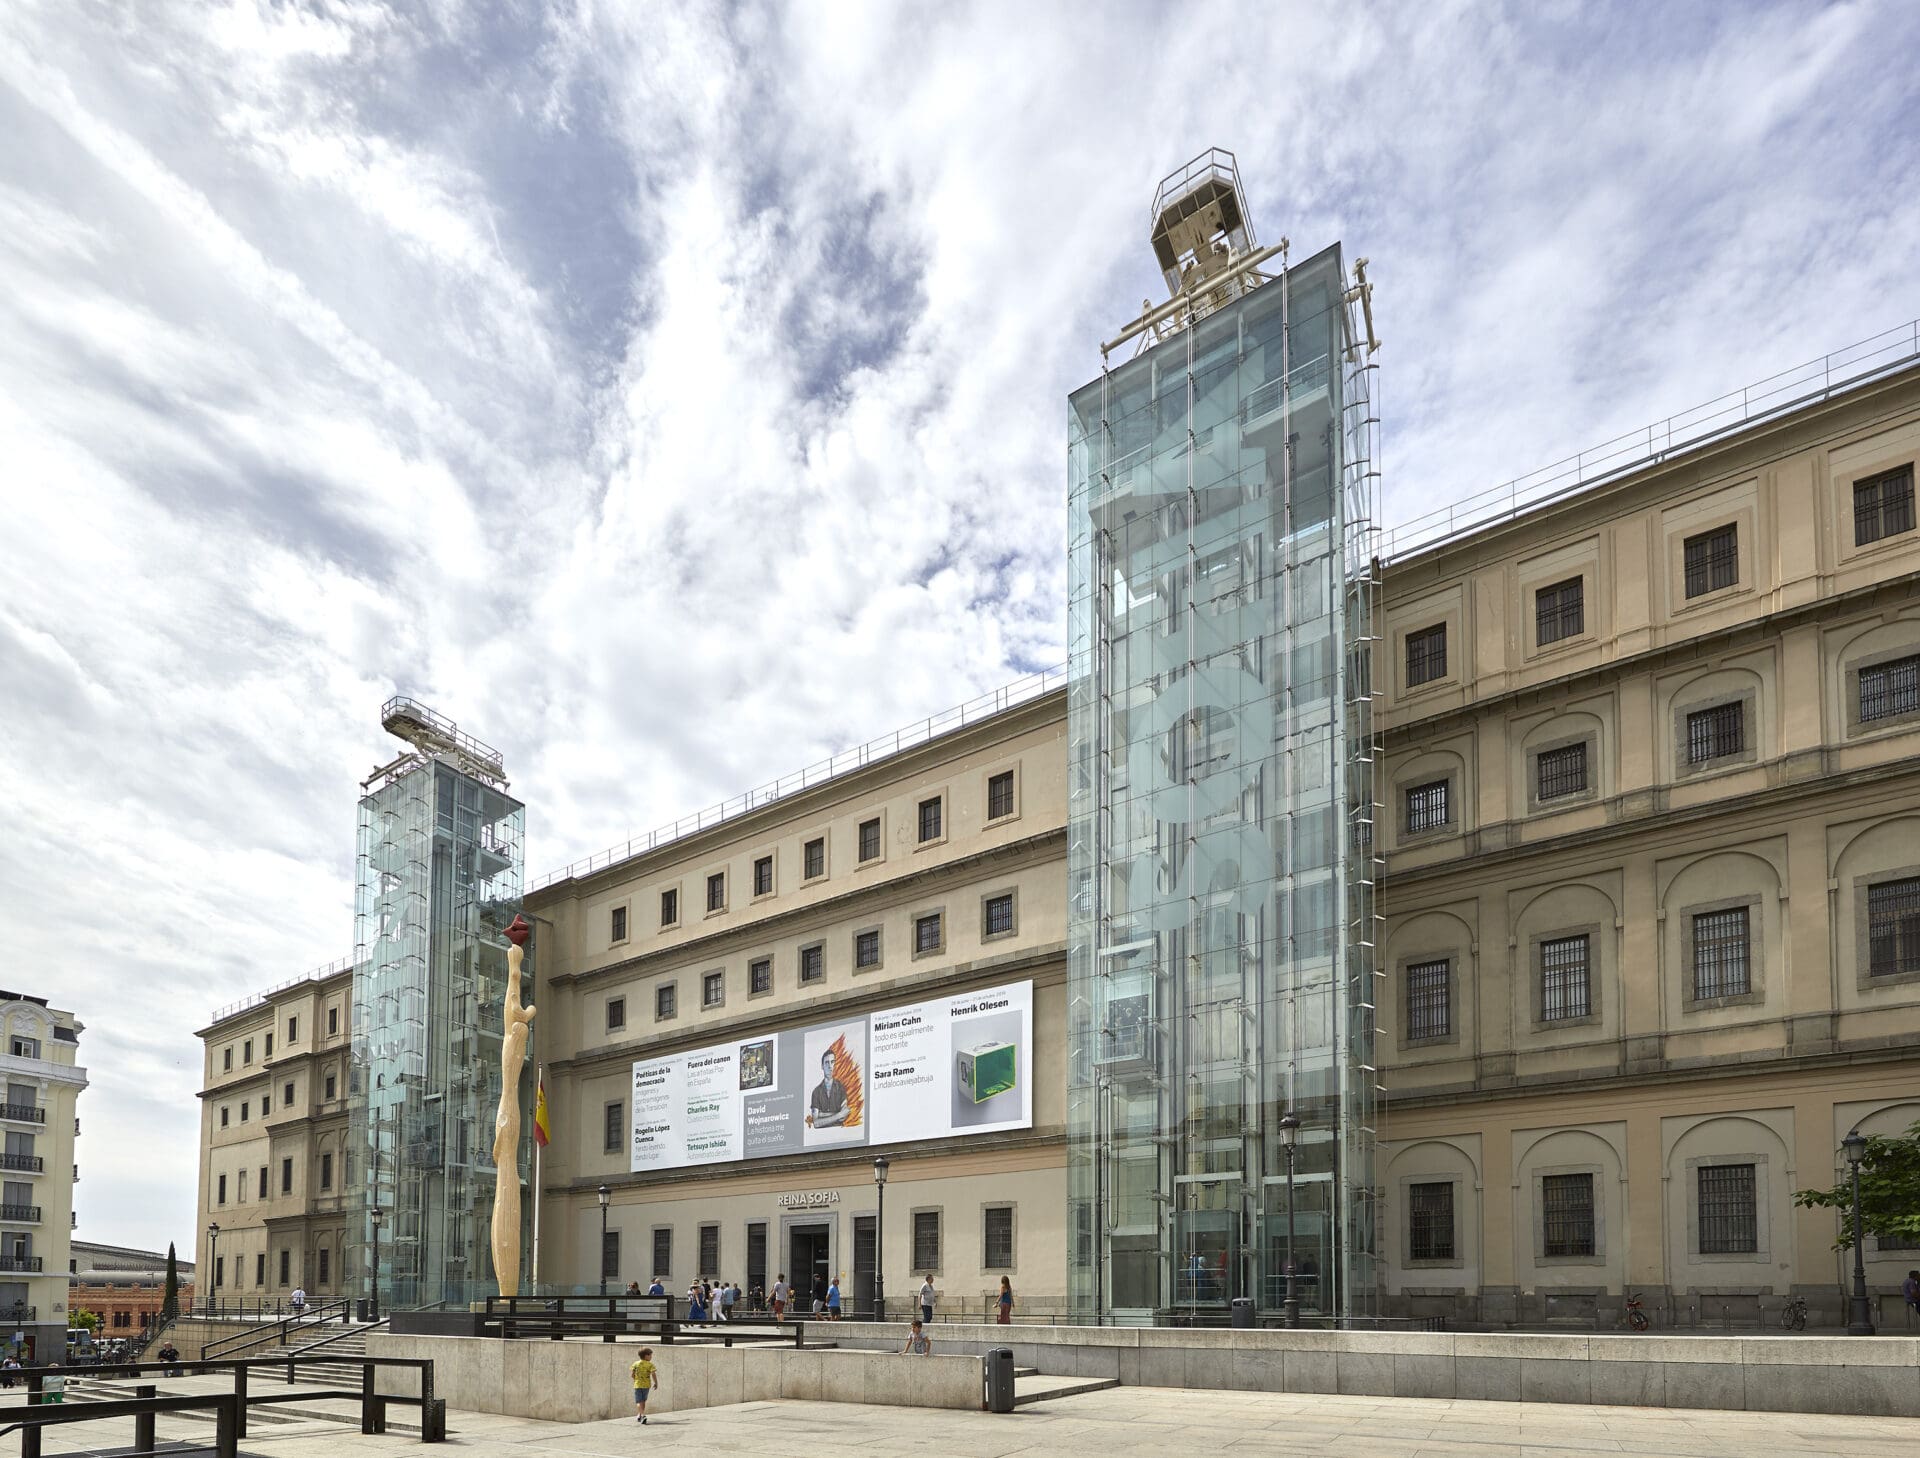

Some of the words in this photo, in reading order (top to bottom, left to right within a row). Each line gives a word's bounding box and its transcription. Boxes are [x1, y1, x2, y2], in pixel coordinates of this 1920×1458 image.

[951, 1003, 977, 1016] Henrik
[979, 1000, 1008, 1011] Olesen
[875, 1021, 900, 1031] Miriam
[902, 1016, 921, 1026] Cahn
[874, 1040, 908, 1053] importante
[688, 1061, 703, 1069] Fuera
[704, 1057, 712, 1066] del
[713, 1055, 731, 1064] canon
[636, 1070, 657, 1079] Poéticas
[659, 1067, 665, 1075] de
[875, 1071, 891, 1079] Sara
[893, 1067, 915, 1076] Ramo
[636, 1077, 665, 1088] democracia
[687, 1105, 708, 1114] Charles
[748, 1104, 766, 1115] David
[748, 1112, 789, 1125] Wojnarowicz
[635, 1126, 654, 1135] Rogelio
[655, 1125, 670, 1133] López
[687, 1143, 708, 1151] Tetsuya
[709, 1139, 727, 1148] Ishida
[777, 1194, 807, 1206] REINA
[808, 1191, 840, 1204] SOFIA
